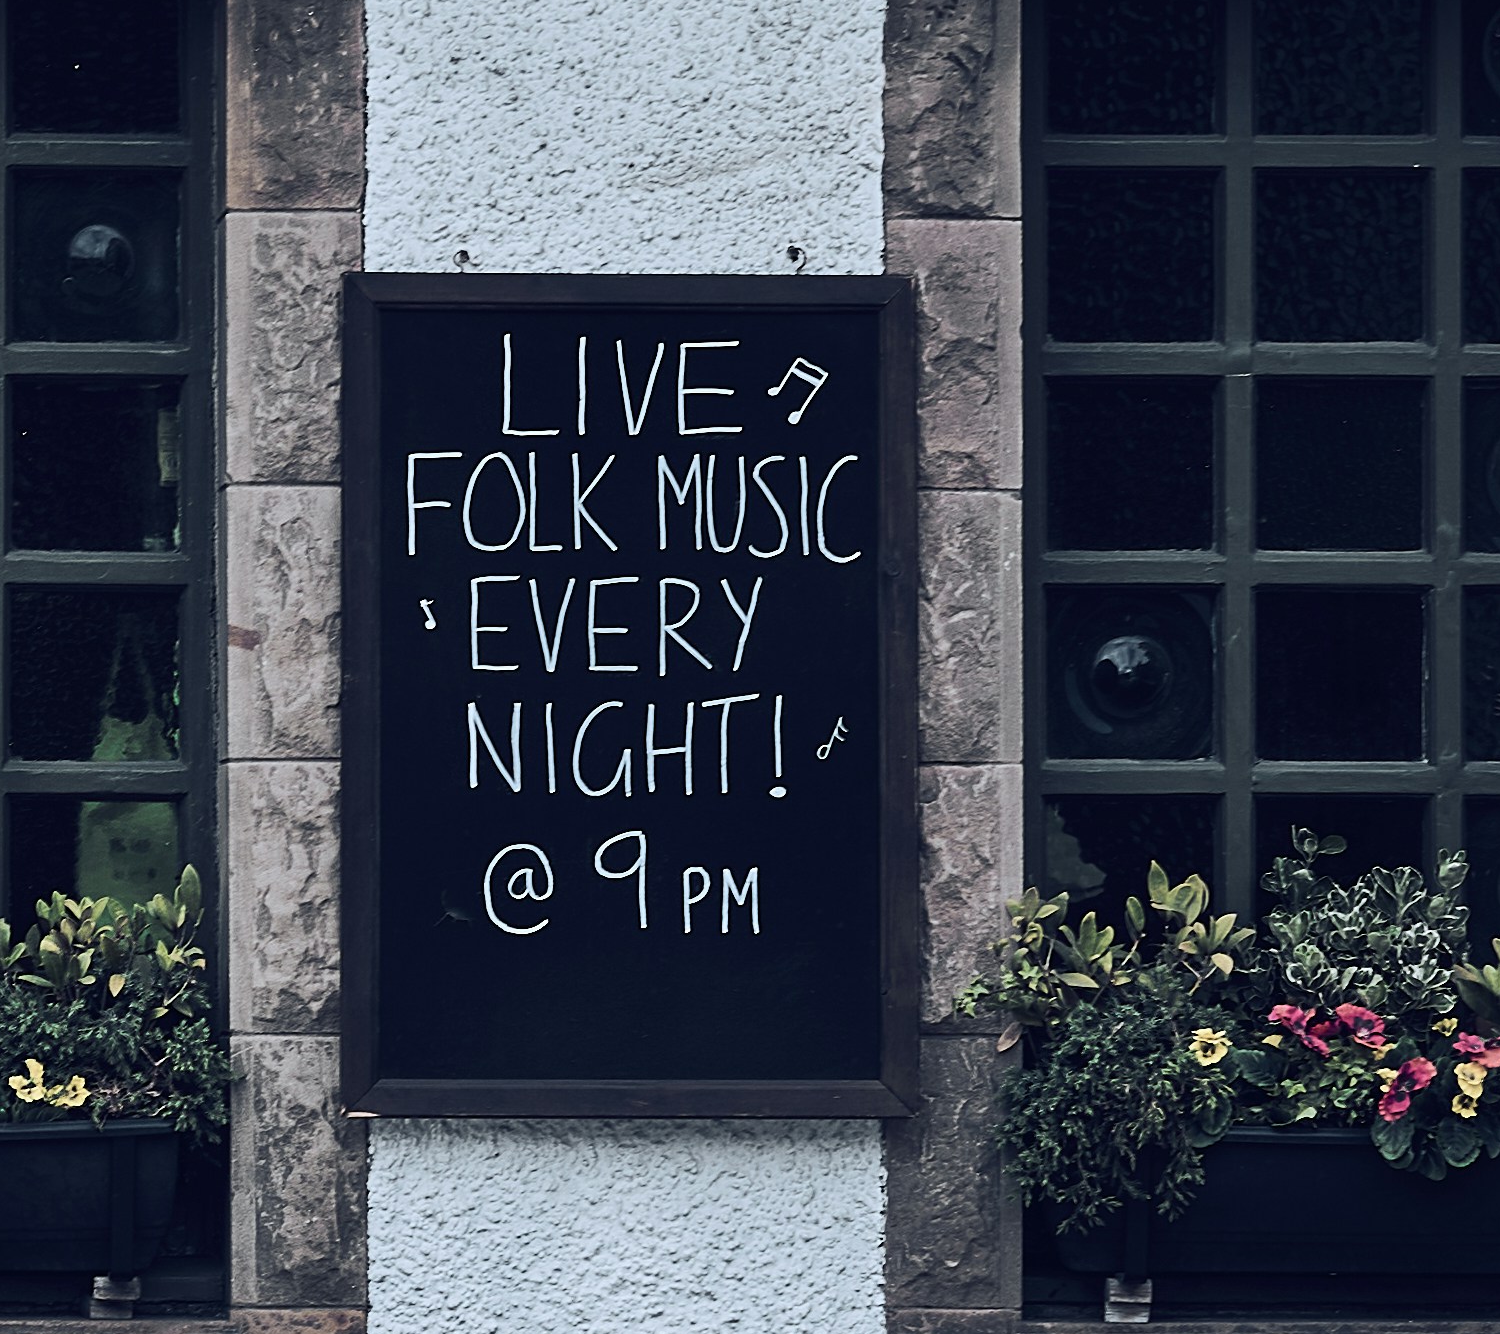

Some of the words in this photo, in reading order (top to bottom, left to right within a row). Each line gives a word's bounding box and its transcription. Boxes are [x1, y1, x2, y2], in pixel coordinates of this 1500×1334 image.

[502, 333, 744, 436] LIVE
[406, 450, 618, 556] FOLK
[657, 453, 862, 564] MUSIC
[470, 575, 763, 677] EVERY
[466, 693, 788, 798] NIGHT!
[483, 842, 555, 935] @
